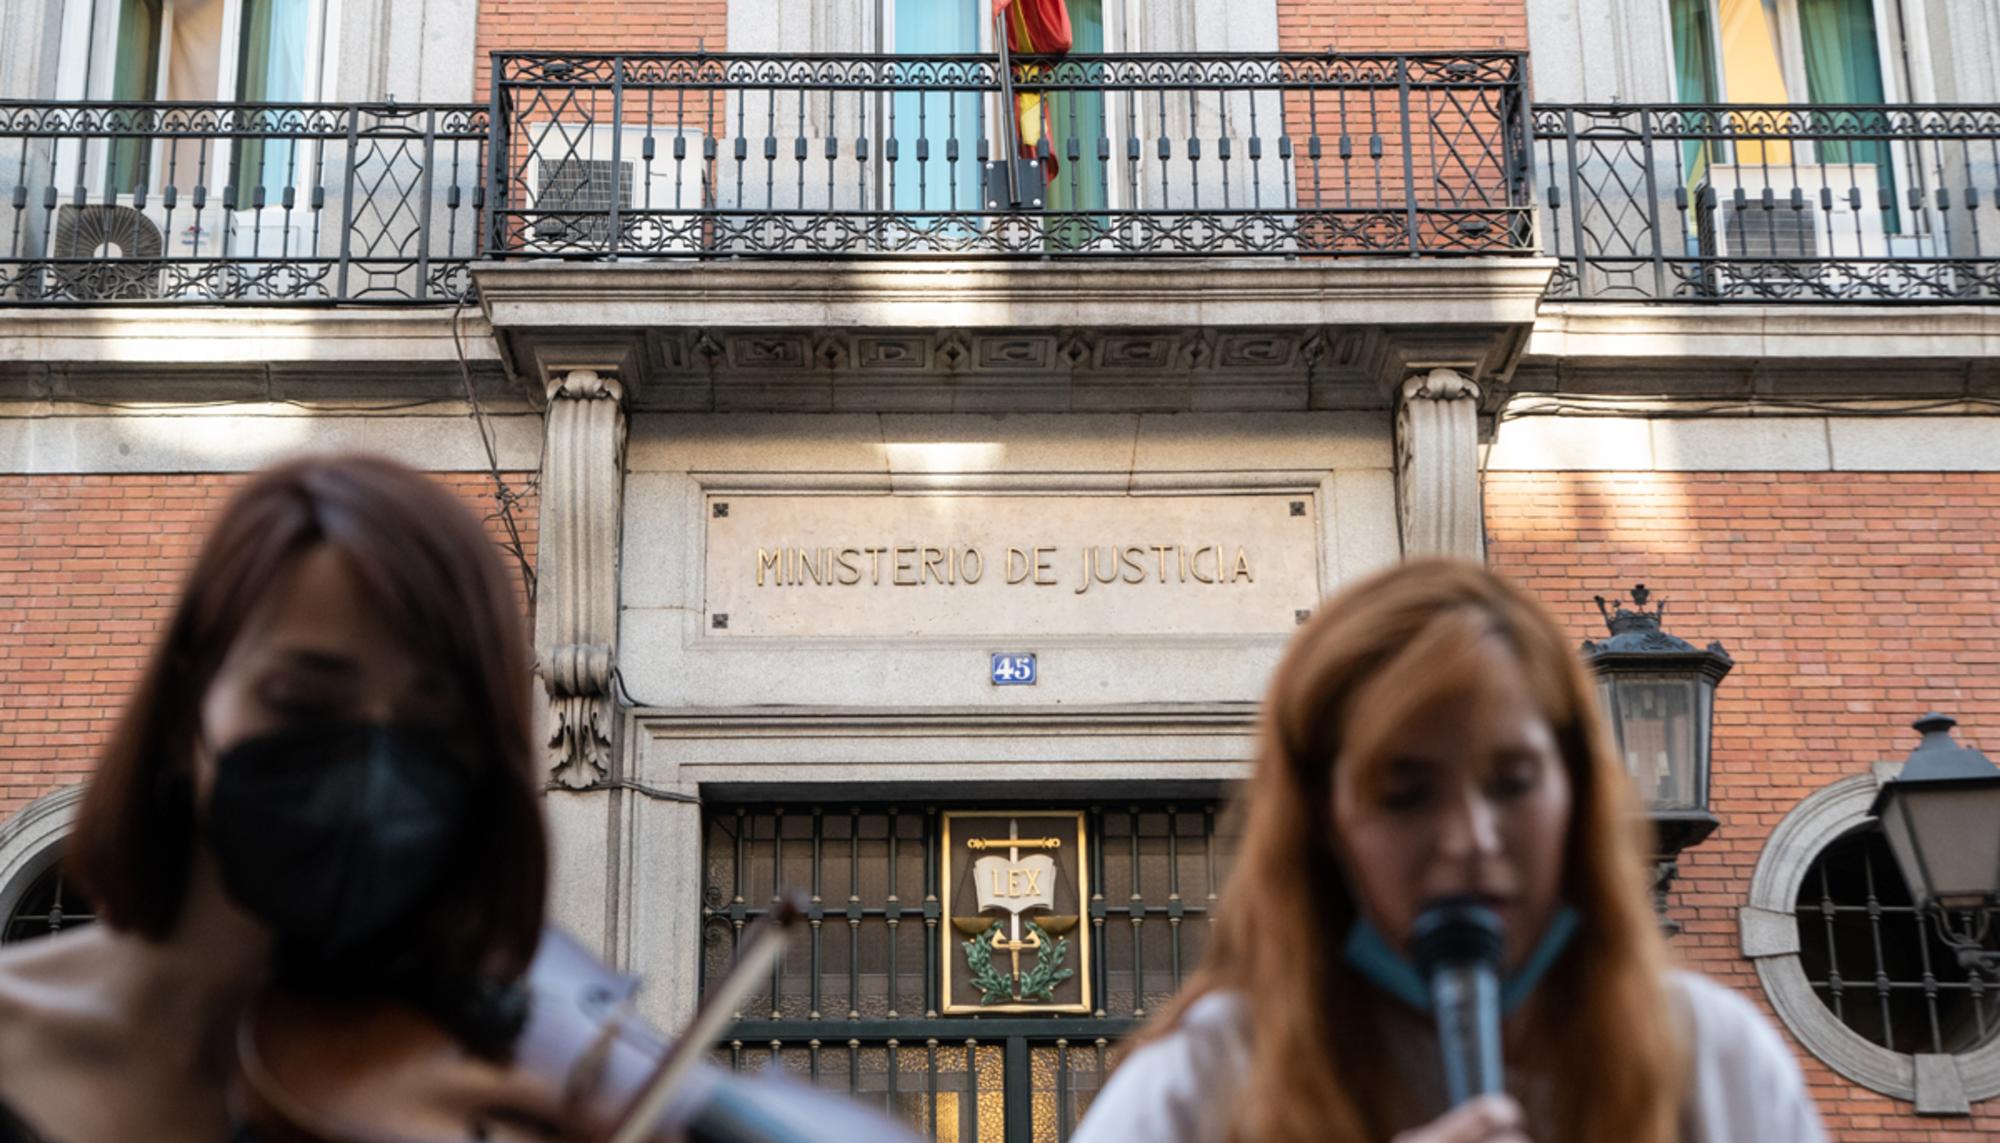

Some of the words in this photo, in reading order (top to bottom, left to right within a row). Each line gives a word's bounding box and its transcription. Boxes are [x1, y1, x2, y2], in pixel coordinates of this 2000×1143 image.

[755, 547, 984, 586] MINISTERIO
[1006, 545, 1058, 586] DE
[1074, 544, 1254, 594] JUSTICIA
[994, 657, 1031, 680] 45
[991, 867, 1041, 899] LEX
